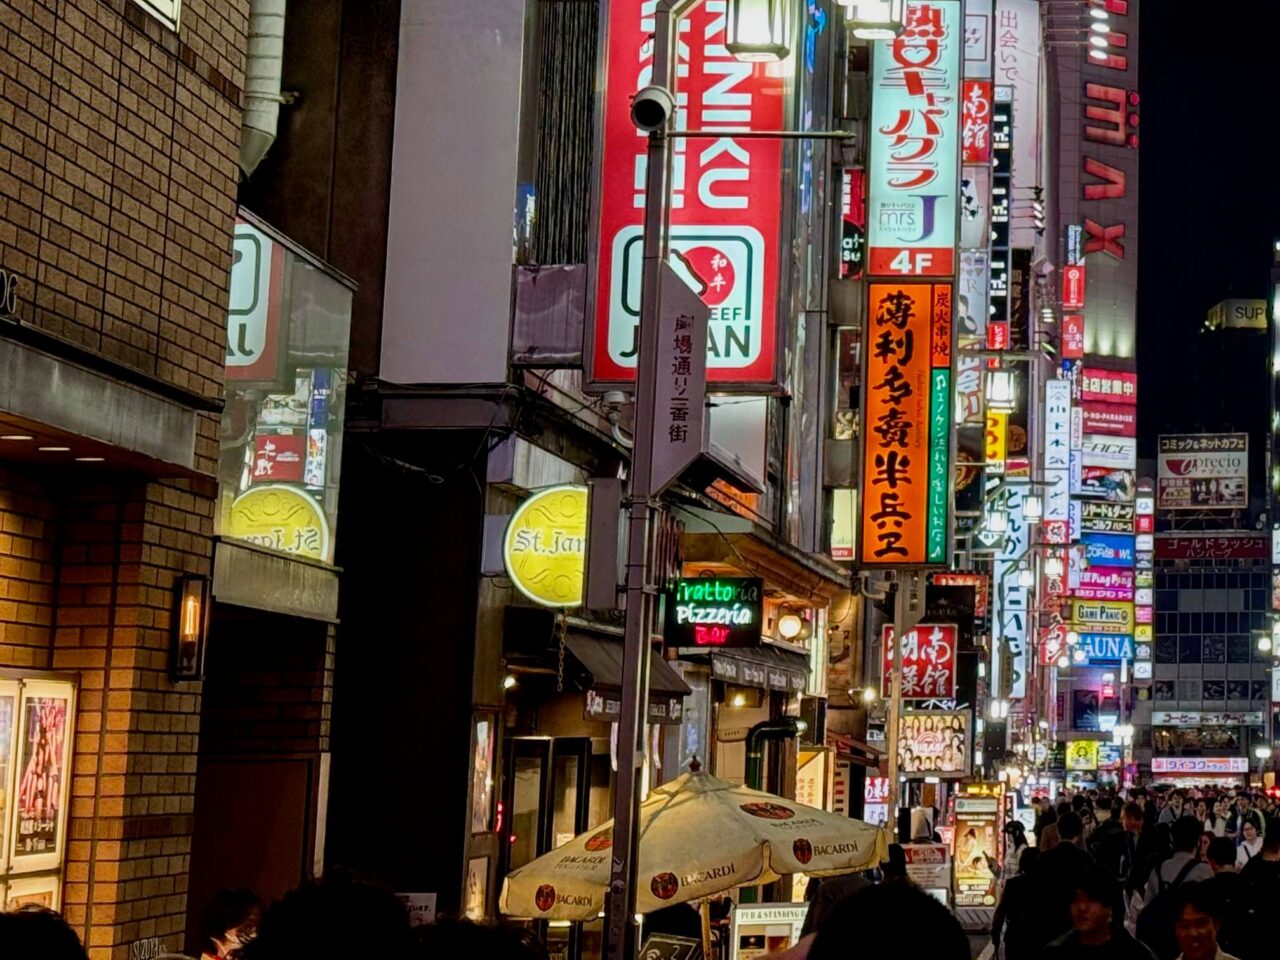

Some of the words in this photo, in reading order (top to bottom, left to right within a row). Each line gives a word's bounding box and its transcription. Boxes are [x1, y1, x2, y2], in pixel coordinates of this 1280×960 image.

[709, 253, 728, 293] 和牛
[890, 251, 933, 275] 4F
[708, 307, 742, 321] EEF
[933, 292, 950, 356] 炭火串焼
[619, 326, 751, 358] JAN
[676, 581, 758, 602] Trattoria
[676, 603, 752, 625] Pizzeria
[1080, 636, 1134, 658] AUNA
